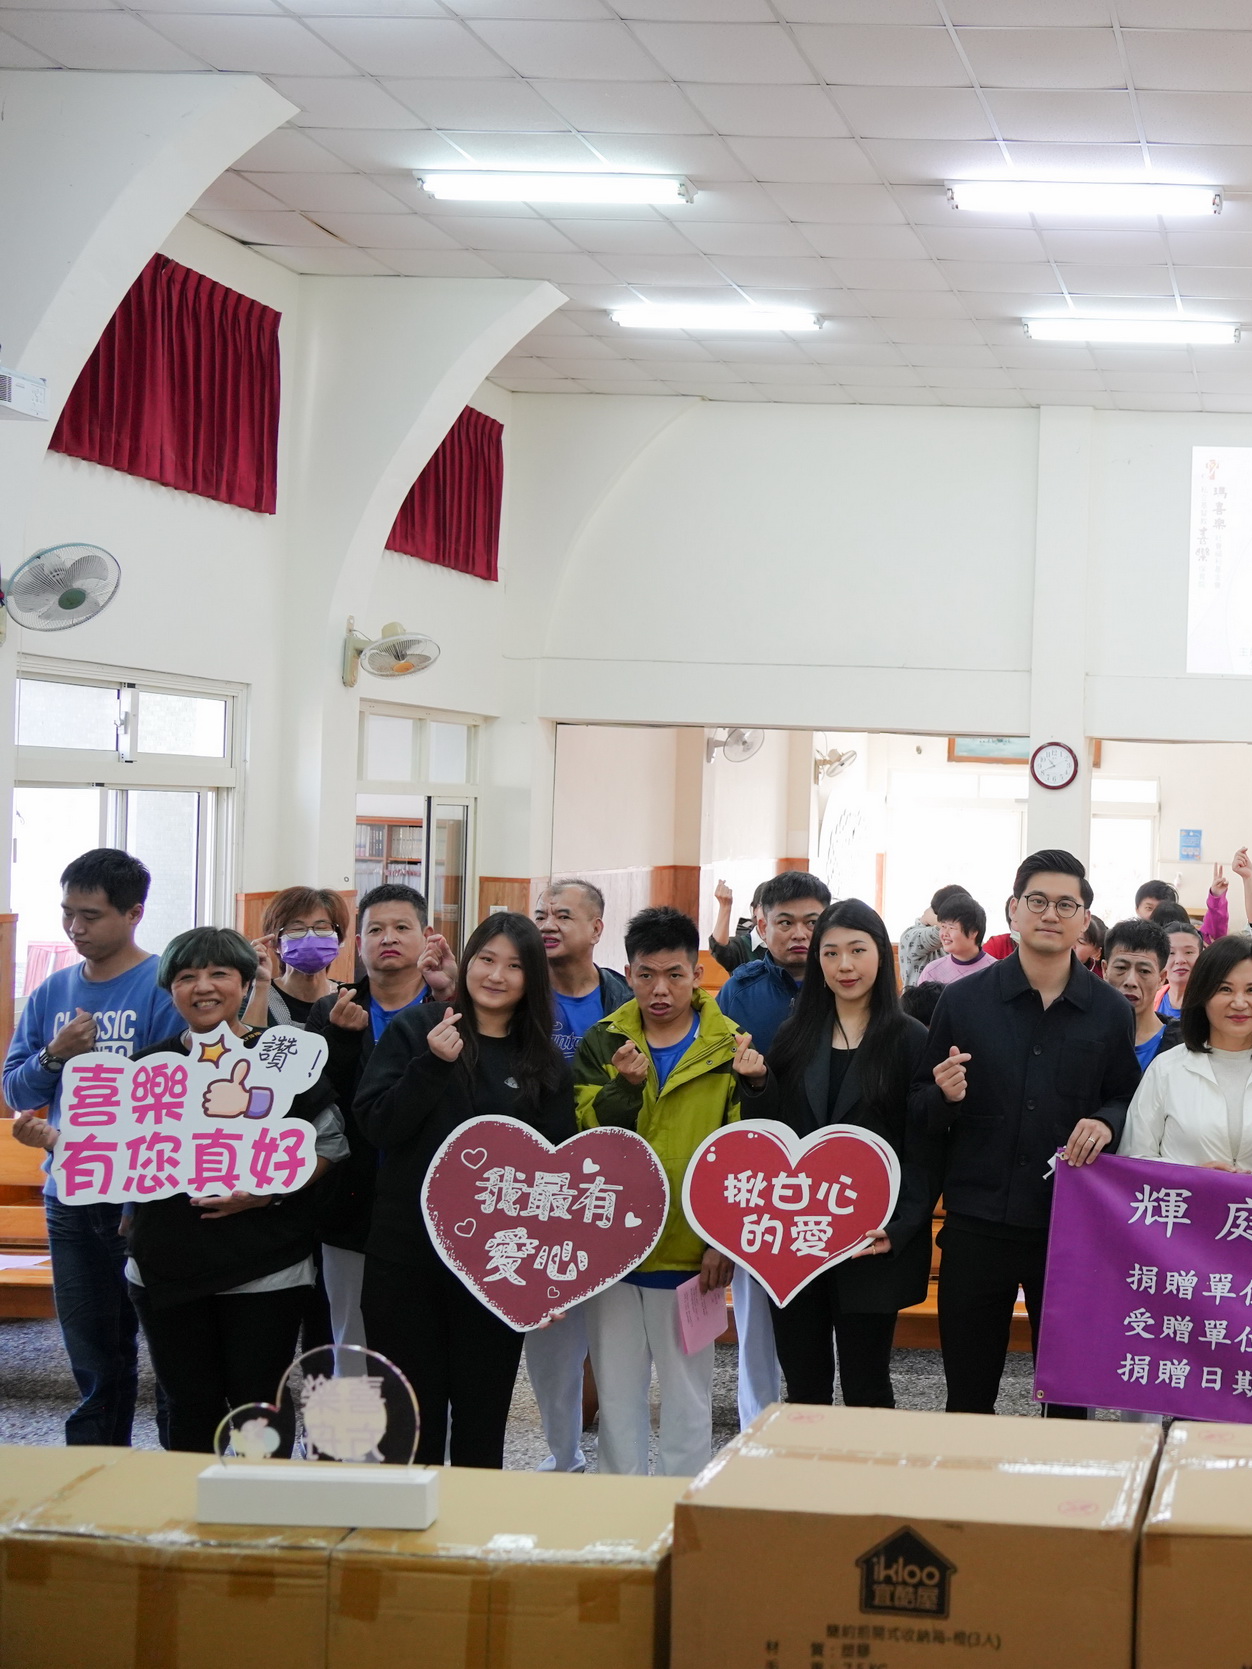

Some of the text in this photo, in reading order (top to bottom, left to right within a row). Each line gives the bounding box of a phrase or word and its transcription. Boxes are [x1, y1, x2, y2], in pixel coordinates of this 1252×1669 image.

[53, 1009, 137, 1040] CSSIC
[68, 1063, 189, 1126] 喜樂
[60, 1127, 306, 1197] 有您真好
[475, 1167, 623, 1228] 我最有
[723, 1170, 858, 1215] 揪甘心
[483, 1226, 589, 1286] 愛心
[741, 1215, 835, 1258] 的愛
[872, 1556, 940, 1585] ikloo
[872, 1584, 940, 1611] 宜酷屋
